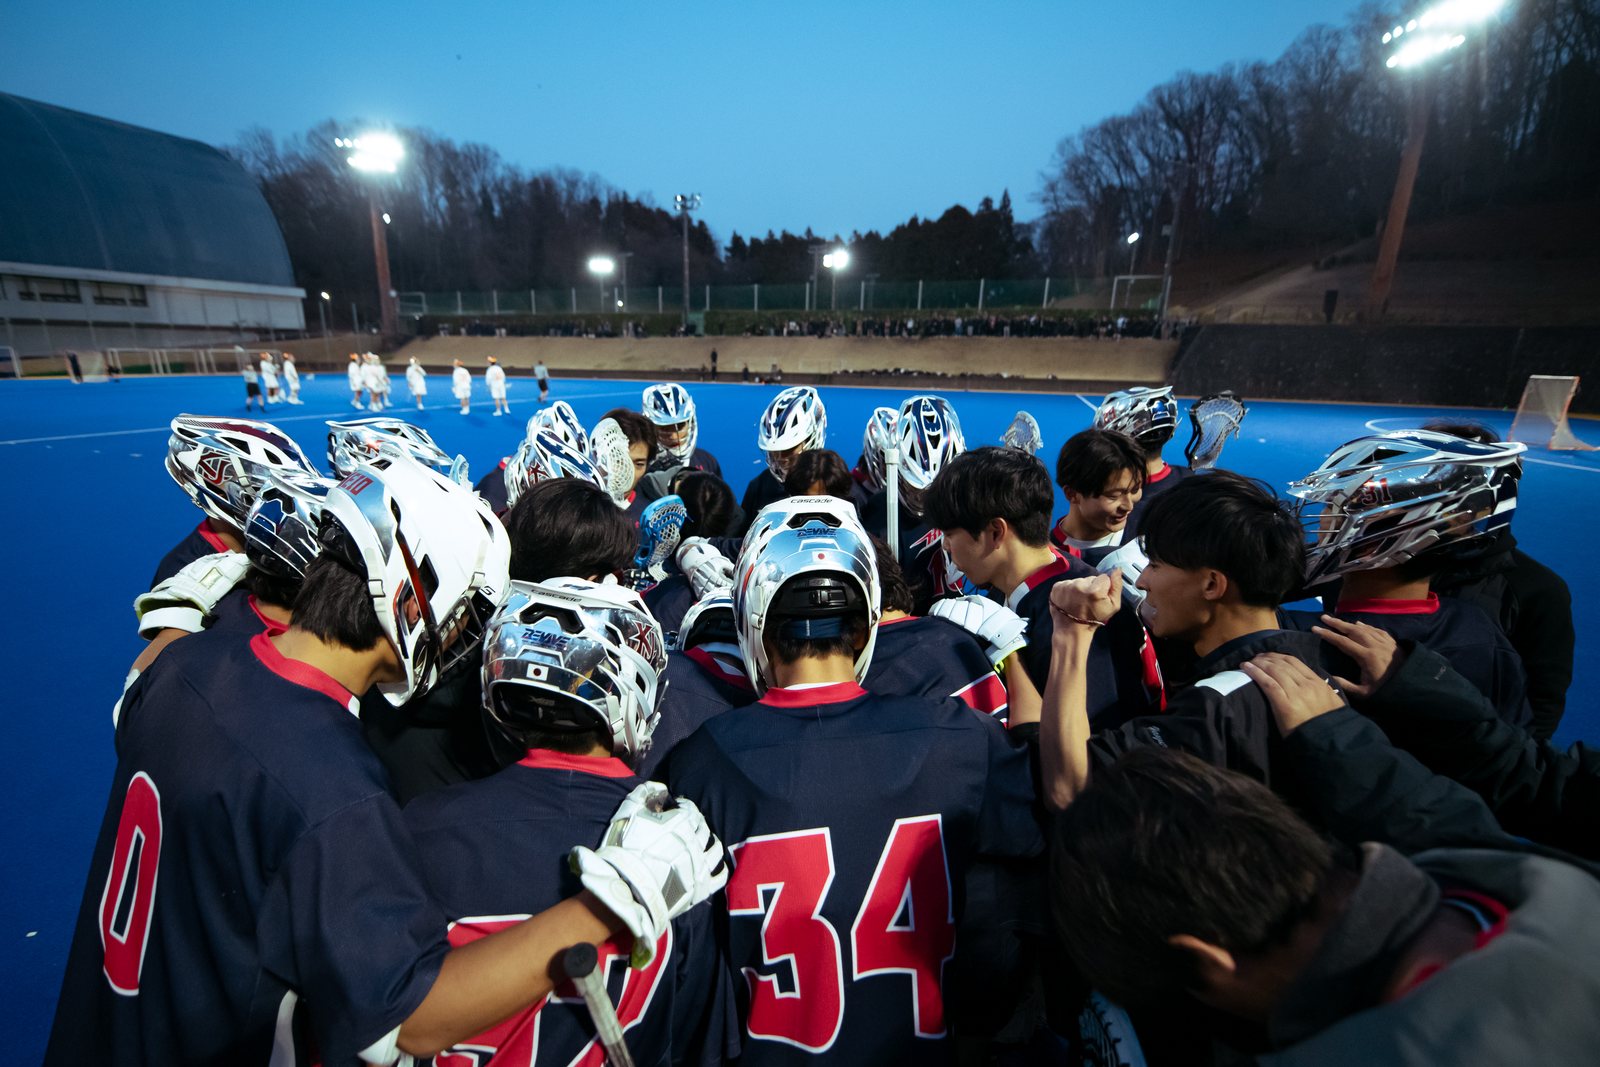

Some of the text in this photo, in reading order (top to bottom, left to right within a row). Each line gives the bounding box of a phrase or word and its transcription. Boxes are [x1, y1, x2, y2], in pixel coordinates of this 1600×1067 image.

[530, 588, 583, 604] cascade
[520, 627, 572, 646] REVIVE
[727, 813, 956, 1055] 34
